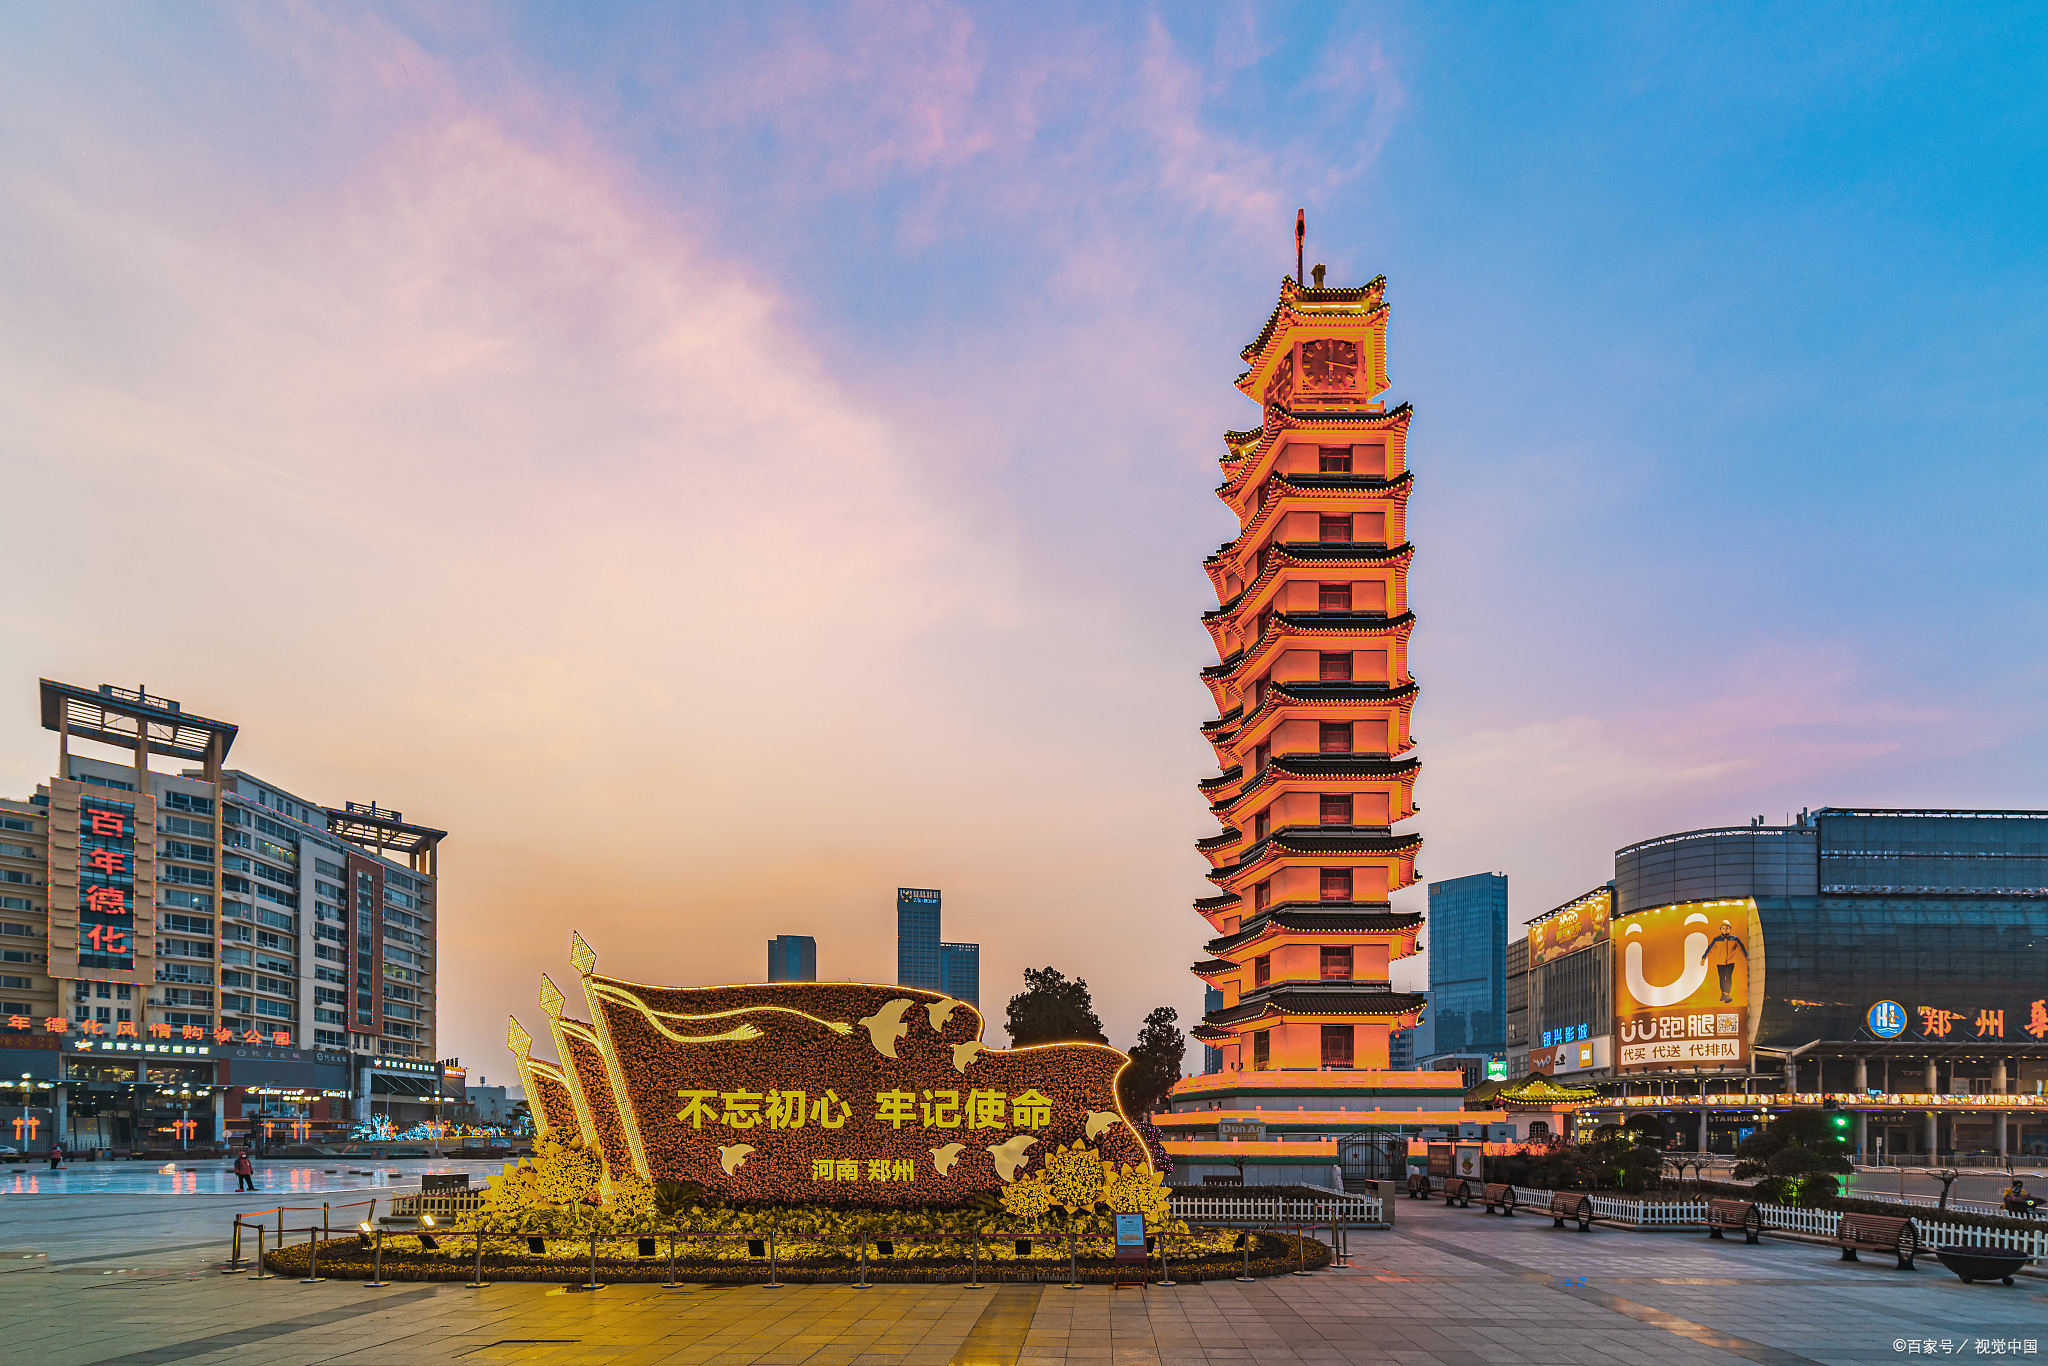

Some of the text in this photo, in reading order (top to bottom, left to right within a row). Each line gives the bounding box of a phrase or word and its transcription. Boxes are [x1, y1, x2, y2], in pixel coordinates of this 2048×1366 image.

[86, 808, 126, 954] 百年德化
[1542, 1022, 1588, 1048] 银兴影城
[1623, 1043, 1735, 1062] 代买 代送 代排队
[1902, 1069, 1941, 1077] TOPSPS
[676, 1088, 1053, 1130] 不忘初心 牢记使命
[1706, 1115, 1760, 1123] STARBUC
[811, 1158, 914, 1182] 河南 郑州
